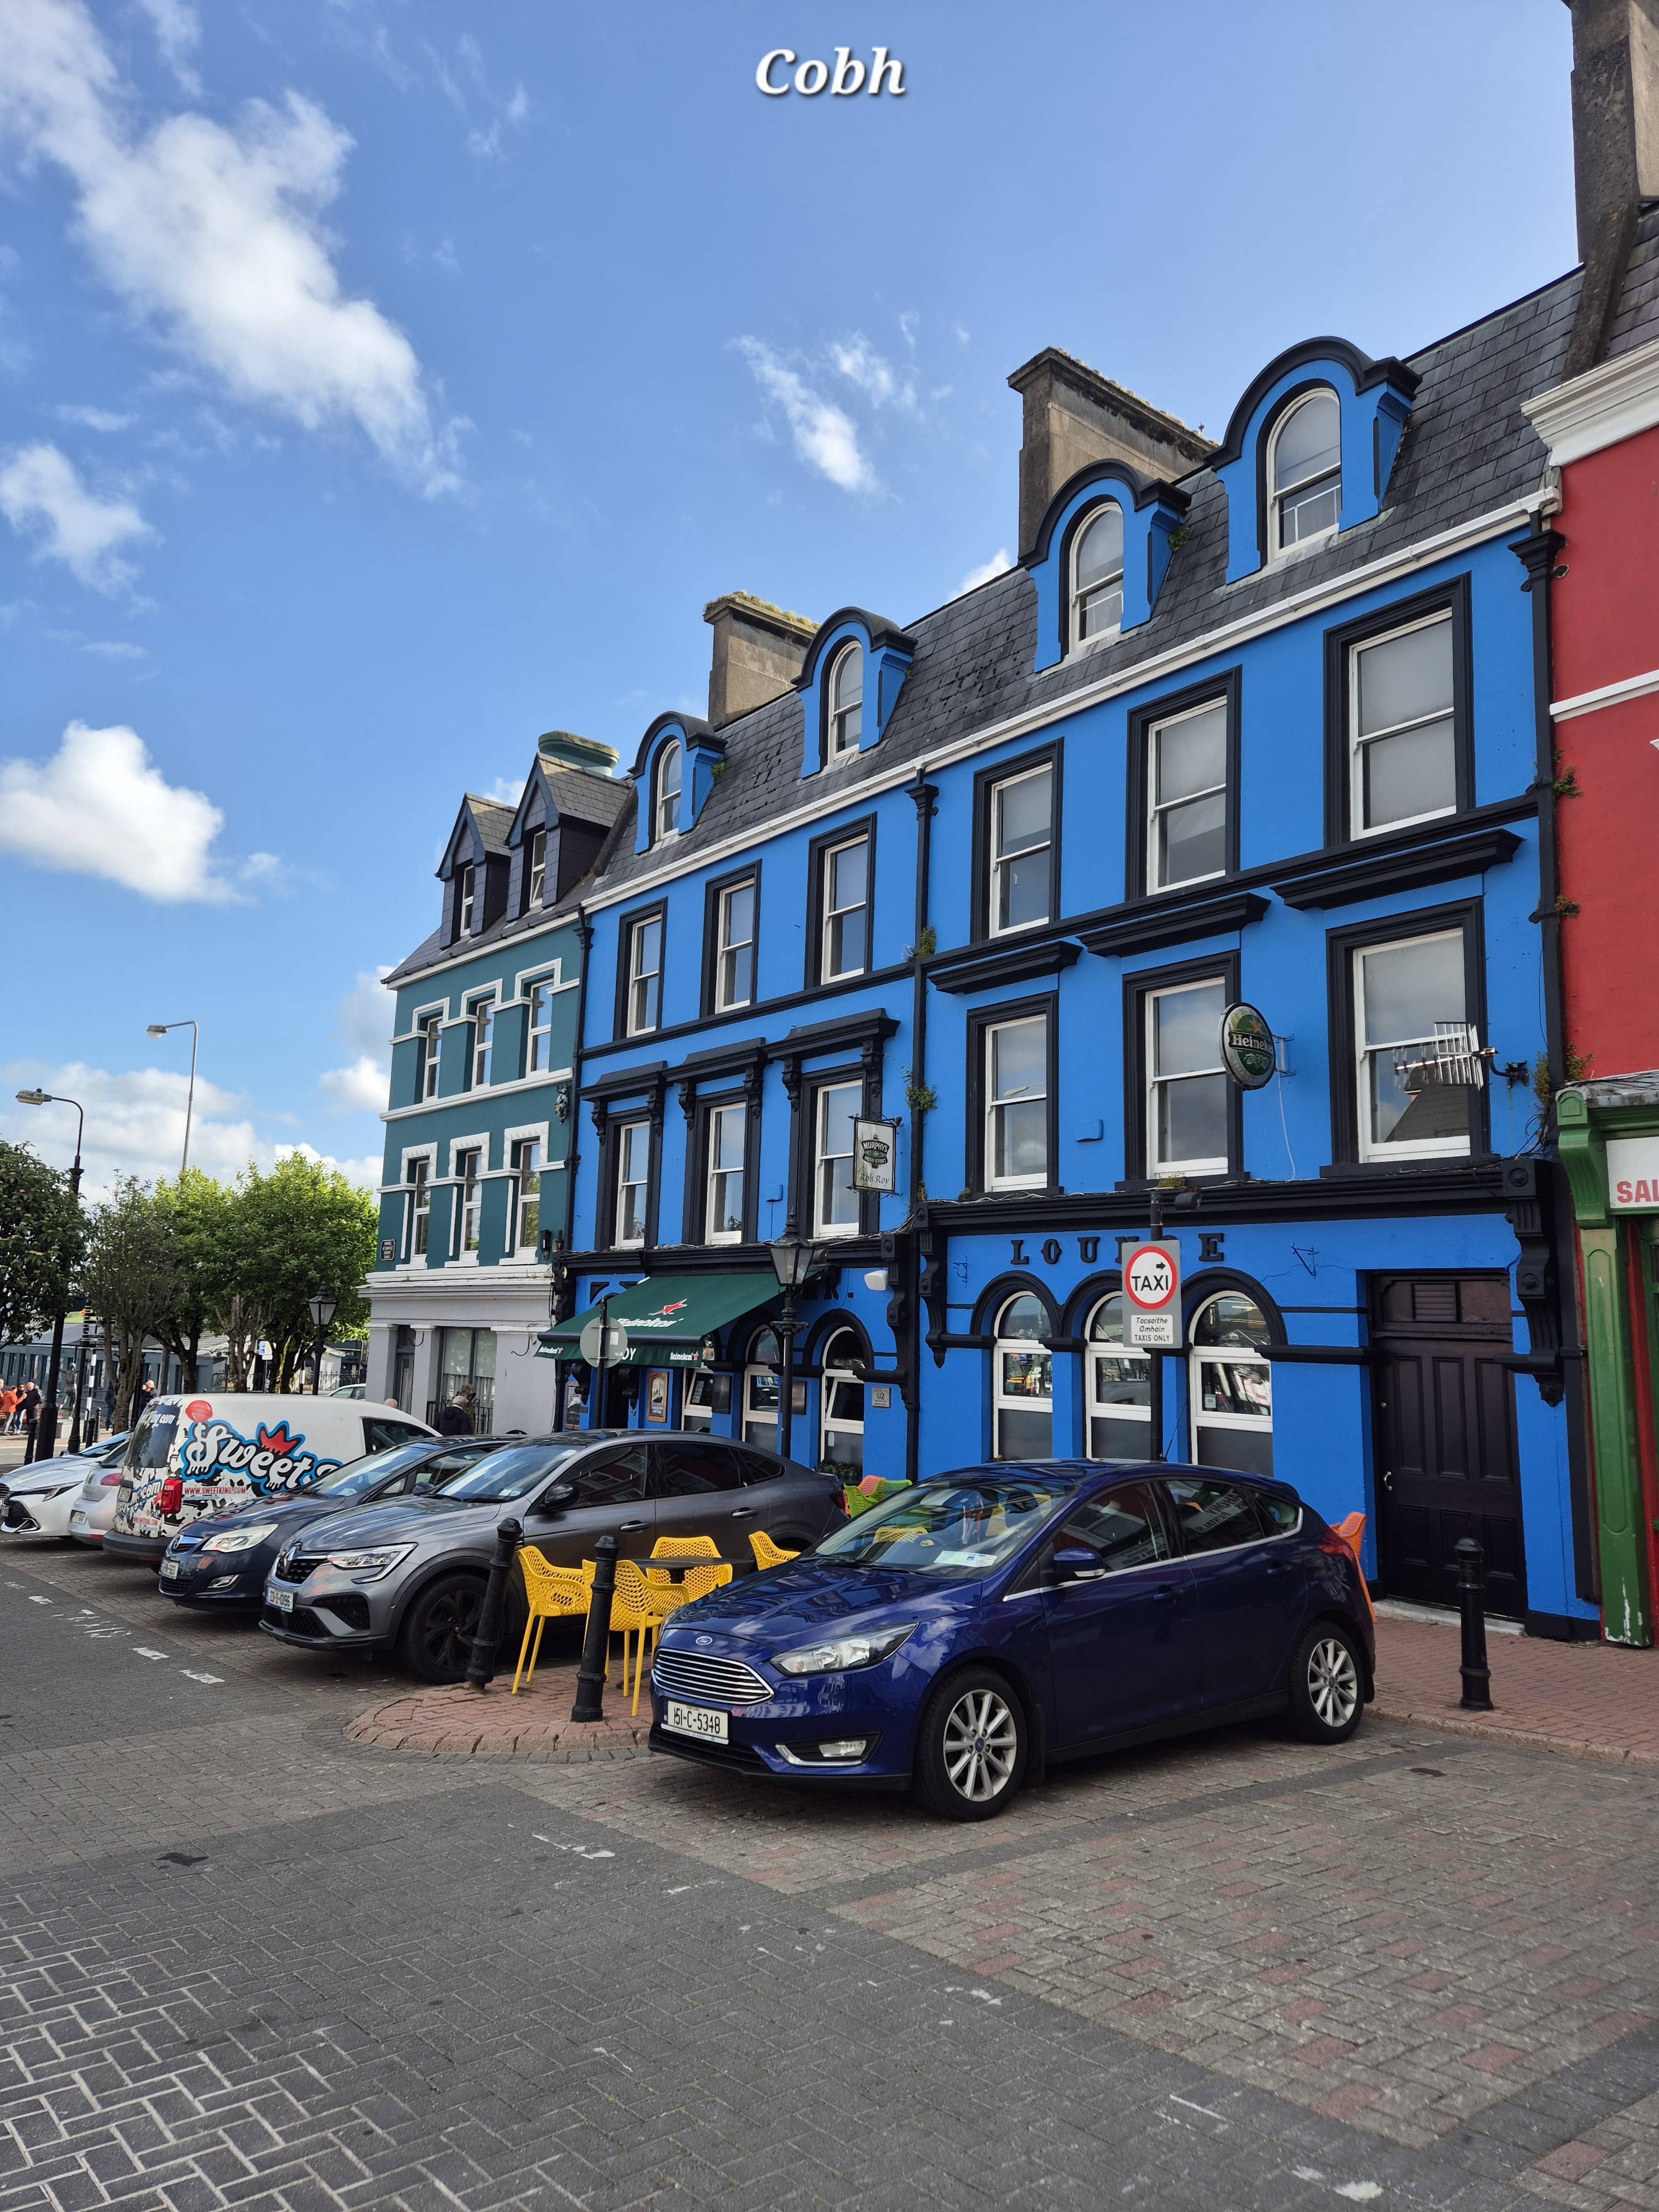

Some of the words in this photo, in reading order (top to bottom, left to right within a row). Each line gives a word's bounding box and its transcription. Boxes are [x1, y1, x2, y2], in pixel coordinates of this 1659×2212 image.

[1232, 1034, 1272, 1052] Heineke
[876, 1175, 889, 1187] Roy
[1010, 1233, 1224, 1265] LOUE
[1131, 1275, 1168, 1291] TAXI
[622, 1348, 637, 1360] OY
[674, 1707, 721, 1734] 151-C-5348
